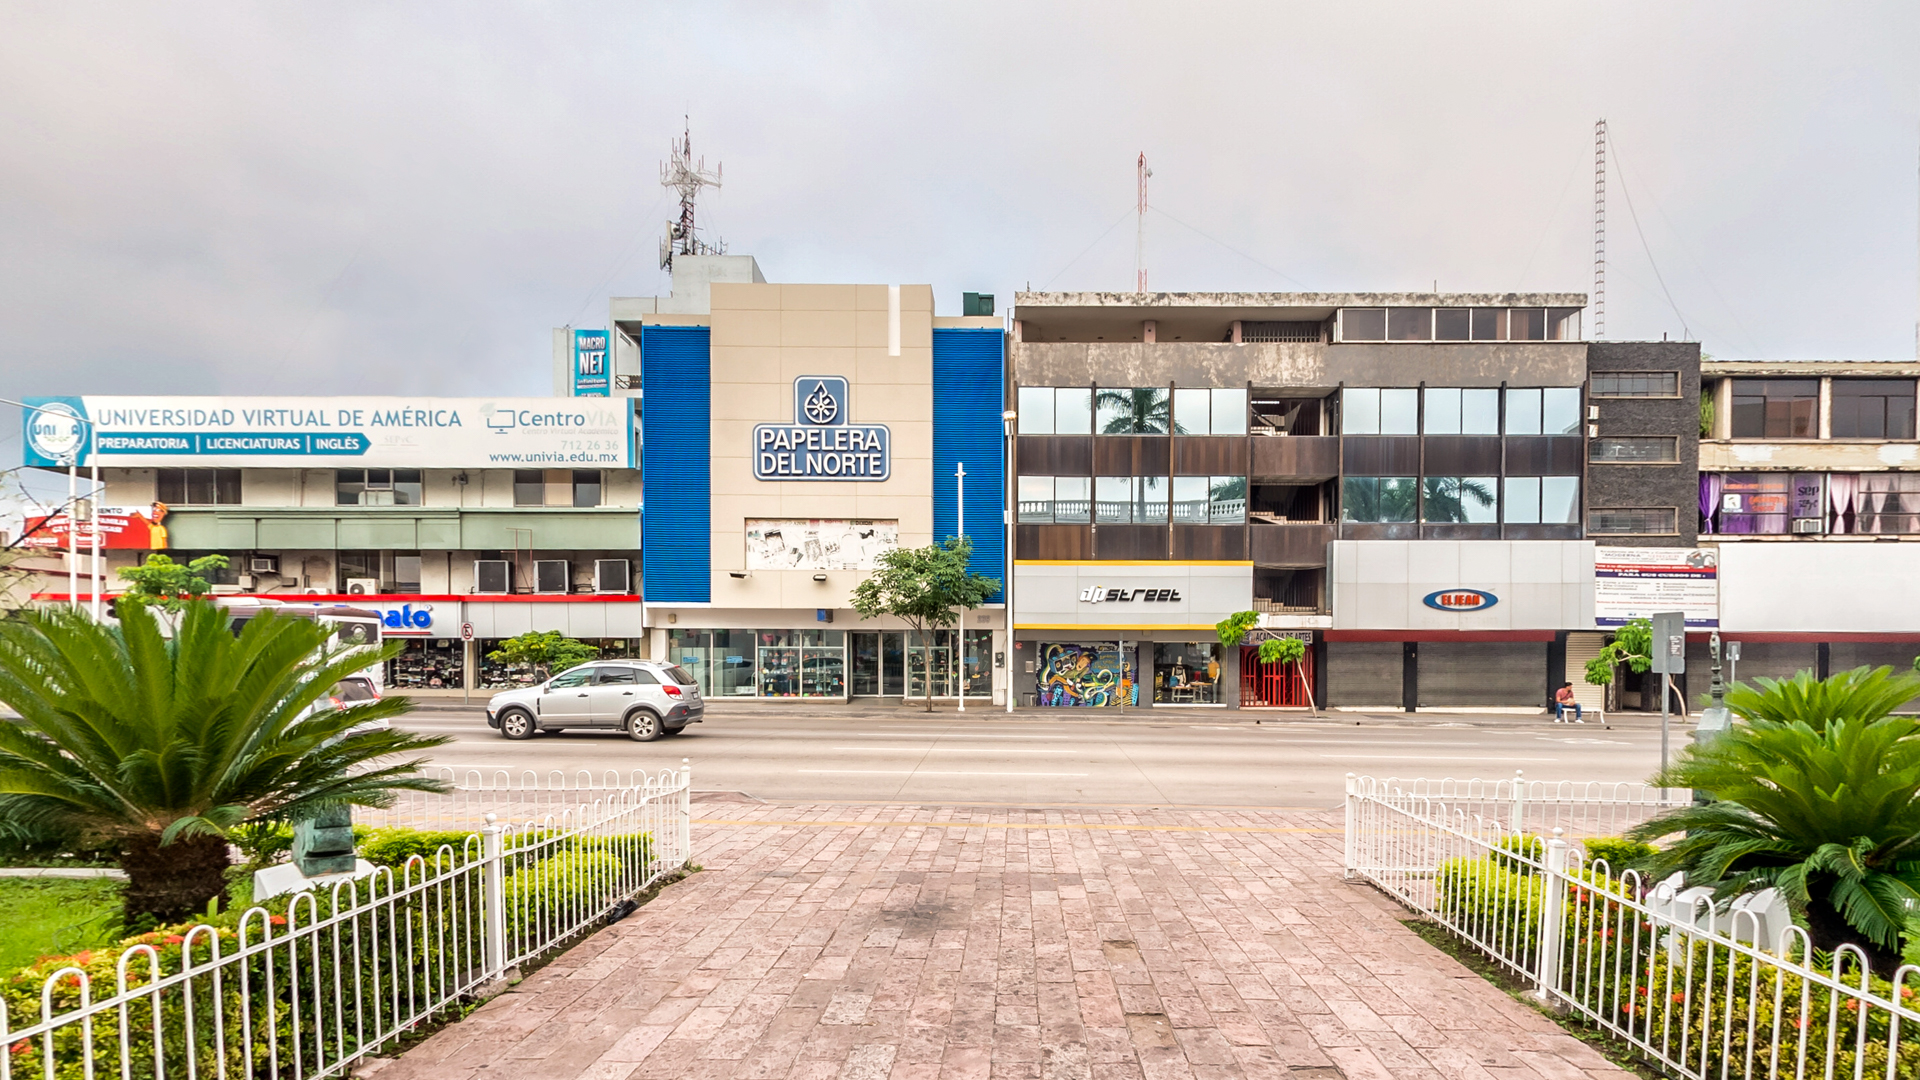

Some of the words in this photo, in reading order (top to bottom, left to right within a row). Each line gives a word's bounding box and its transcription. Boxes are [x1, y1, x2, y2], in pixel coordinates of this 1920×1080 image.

[579, 336, 606, 351] MACRO
[579, 351, 605, 375] NET
[98, 408, 235, 427] UNIVERSIDAD
[243, 409, 331, 427] VIRTUAL
[338, 409, 363, 427] DE
[370, 405, 462, 428] AMÉRICA
[98, 437, 190, 449] PREPARATORIA
[206, 437, 300, 449] LICENCIATURAS
[316, 435, 360, 450] INGLÉS
[561, 440, 582, 450] 712
[587, 440, 601, 450] 26
[605, 440, 619, 450] 36
[760, 429, 882, 451] PAPELERA
[489, 451, 618, 463] www.univia.edu.mx
[760, 453, 804, 475] DEL
[806, 453, 882, 475] NORTE
[1080, 584, 1182, 604] dpstreet
[1441, 594, 1453, 606] EL
[1454, 594, 1480, 606] JEAN
